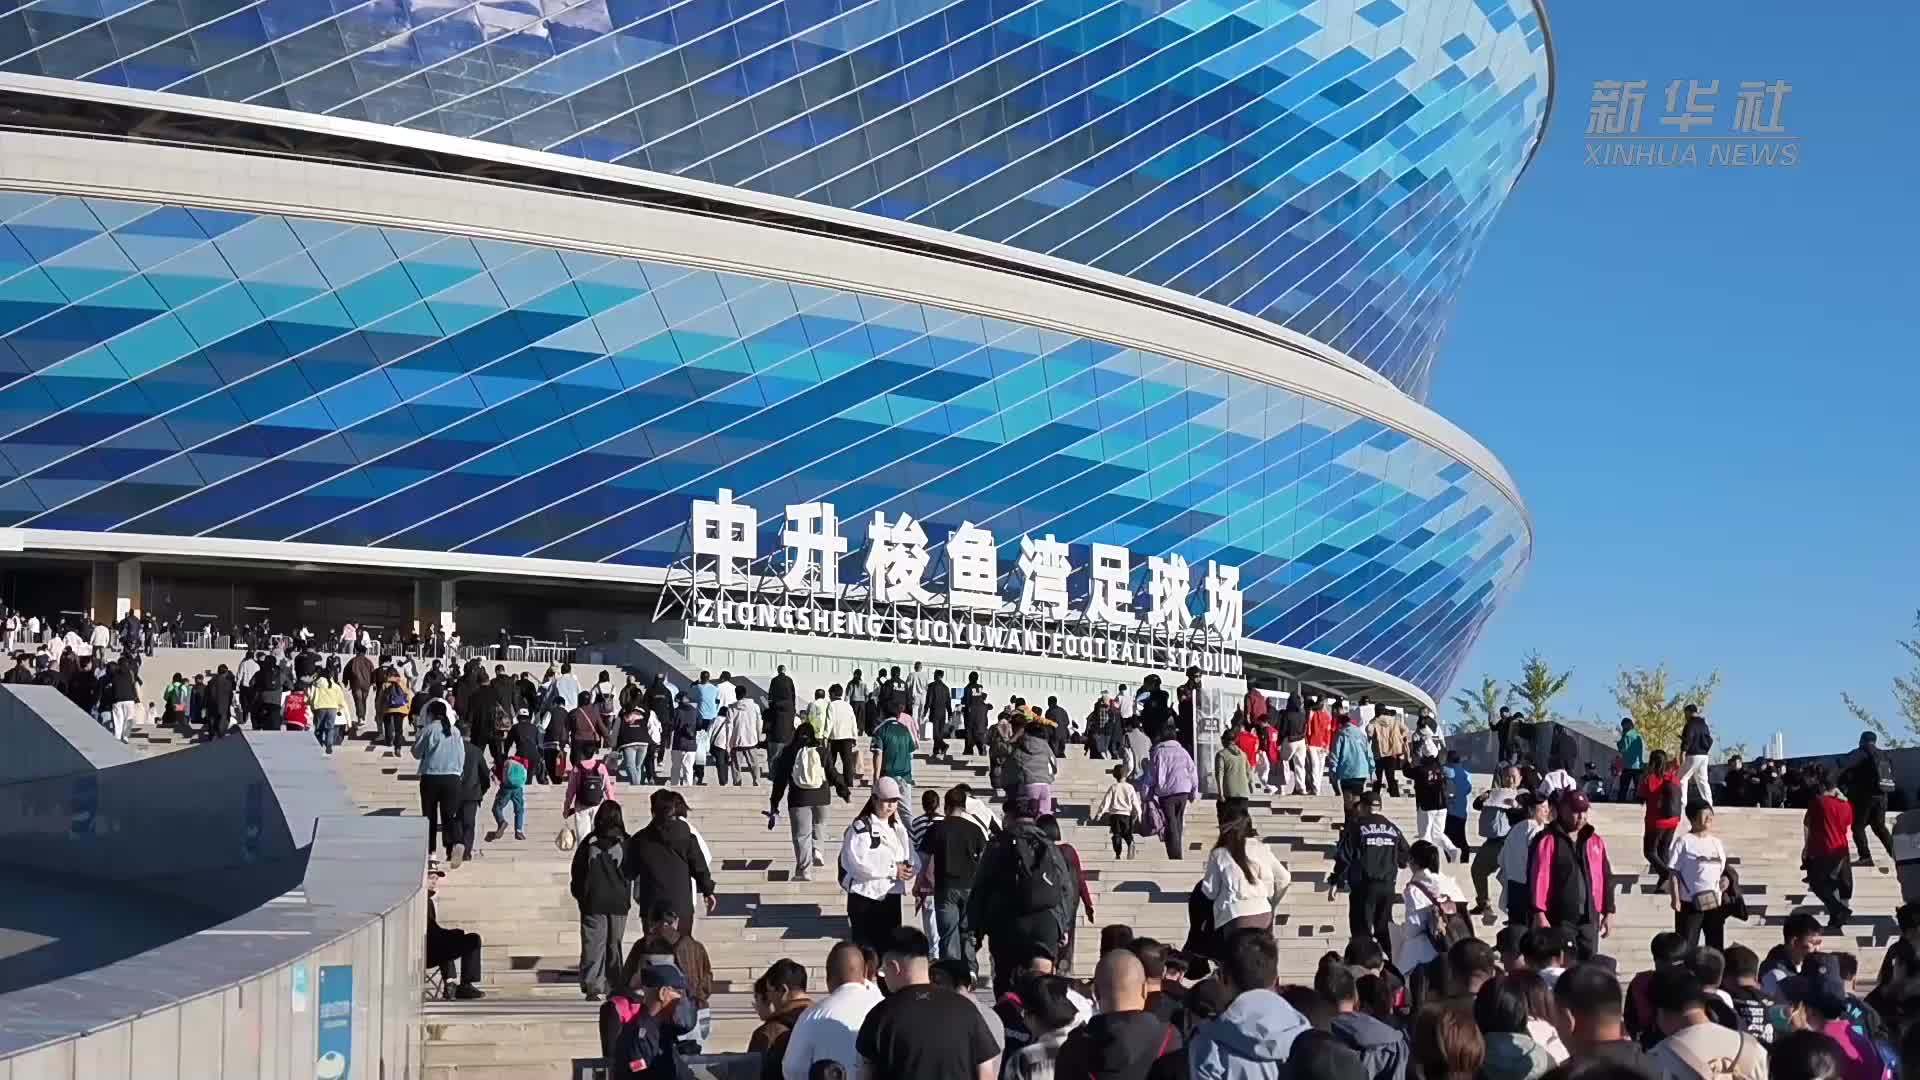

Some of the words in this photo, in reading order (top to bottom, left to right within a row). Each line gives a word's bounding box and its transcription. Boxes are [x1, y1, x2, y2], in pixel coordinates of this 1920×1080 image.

[692, 488, 1243, 641] 中升梭鱼湾足球场
[697, 599, 883, 637] ZHONGSHENG
[899, 616, 1039, 652] SUOYUWAN
[1053, 634, 1154, 665] FOOTBALL
[1167, 646, 1243, 676] STADIUM
